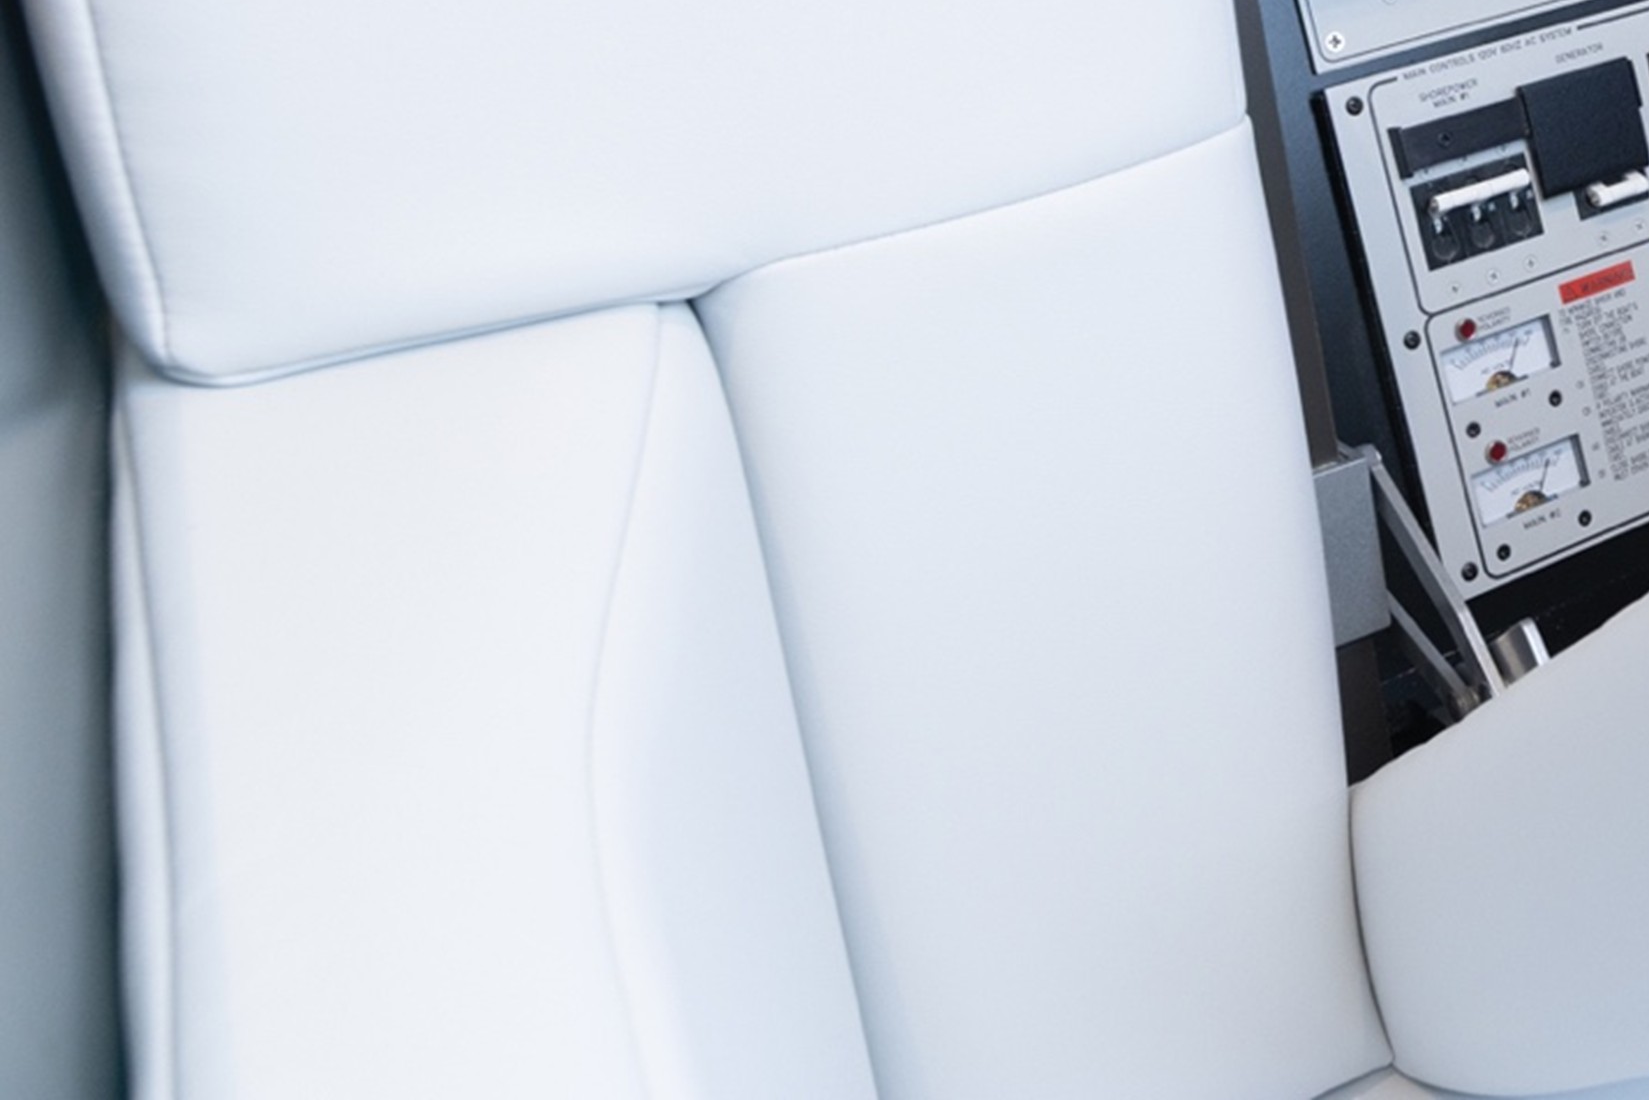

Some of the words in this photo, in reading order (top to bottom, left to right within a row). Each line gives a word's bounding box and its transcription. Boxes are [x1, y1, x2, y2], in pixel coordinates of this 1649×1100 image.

[1402, 66, 1426, 80] MAIN
[1429, 53, 1475, 74] CONTROLS
[1539, 26, 1572, 43] SYSTEM
[1554, 41, 1604, 64] GENERATOR
[1417, 77, 1478, 103] SHOREPOWER
[1432, 95, 1456, 108] MAIN
